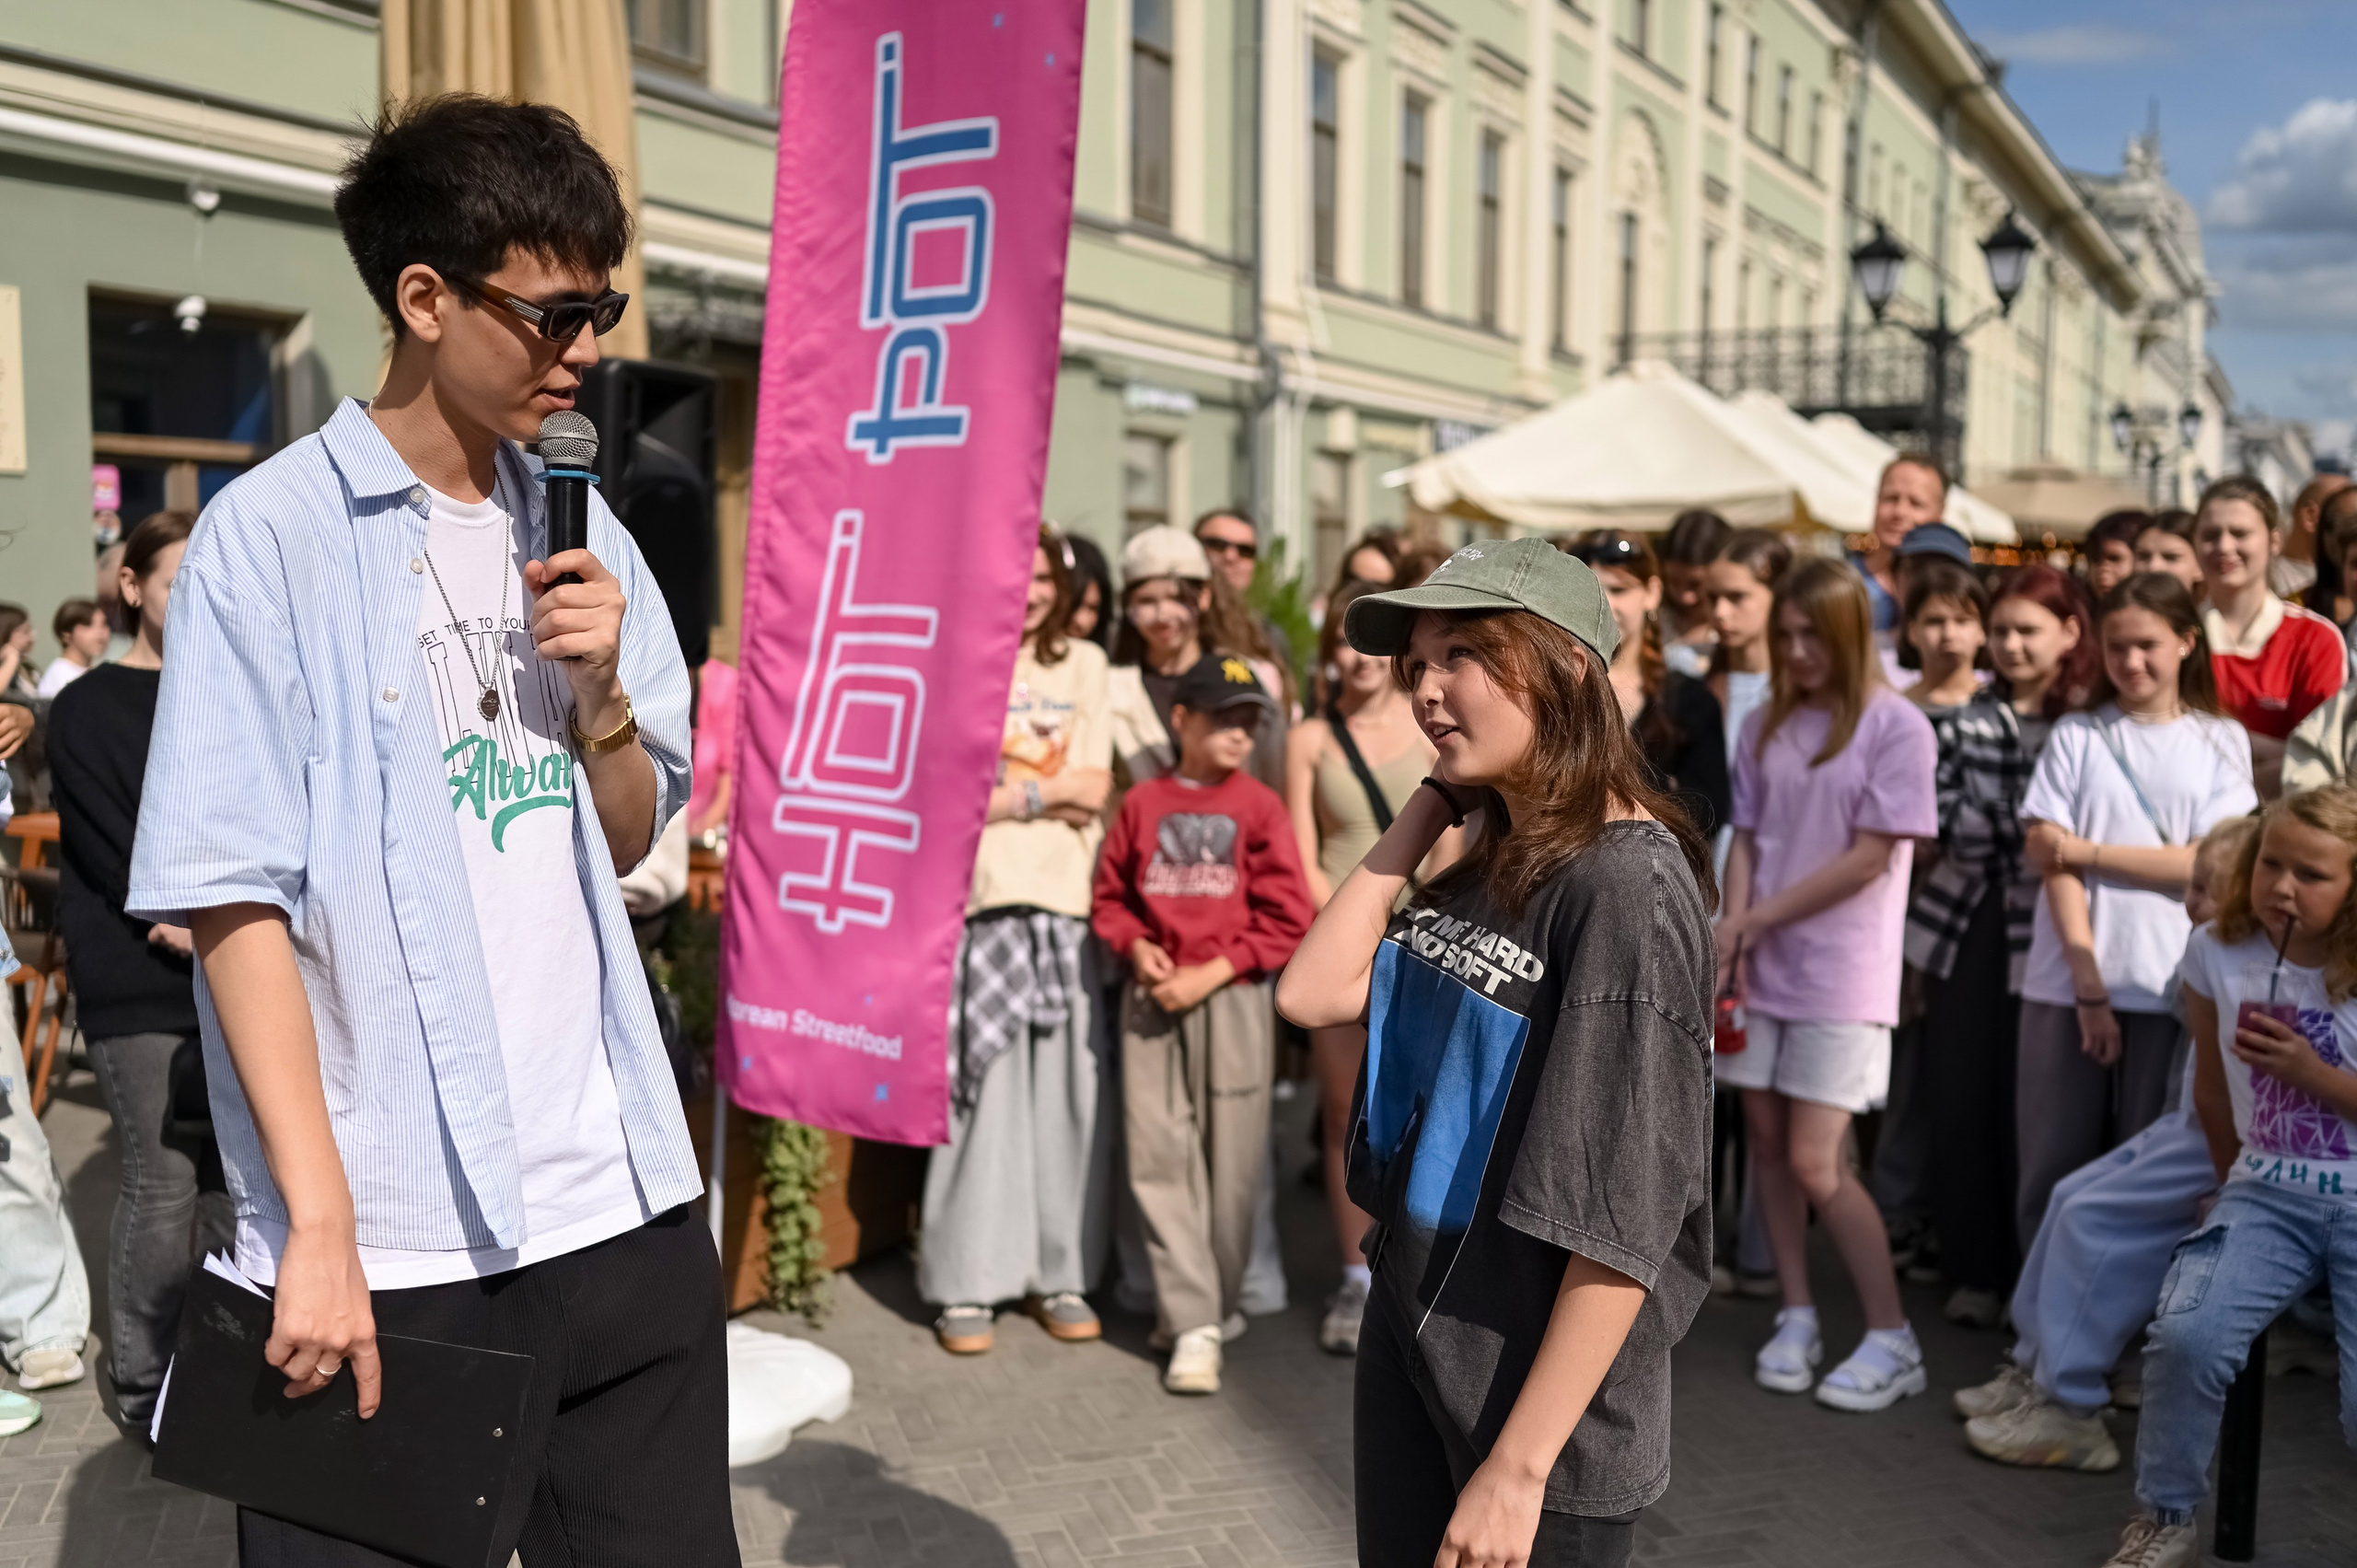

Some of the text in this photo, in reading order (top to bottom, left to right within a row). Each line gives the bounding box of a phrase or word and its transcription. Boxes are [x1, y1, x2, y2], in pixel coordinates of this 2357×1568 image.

[846, 30, 1000, 465] POT
[477, 617, 493, 630] TO
[773, 509, 939, 934] HOT
[1441, 943, 1513, 995] SOFT
[1462, 925, 1544, 982] HARD
[791, 1007, 902, 1062] Streetfood
